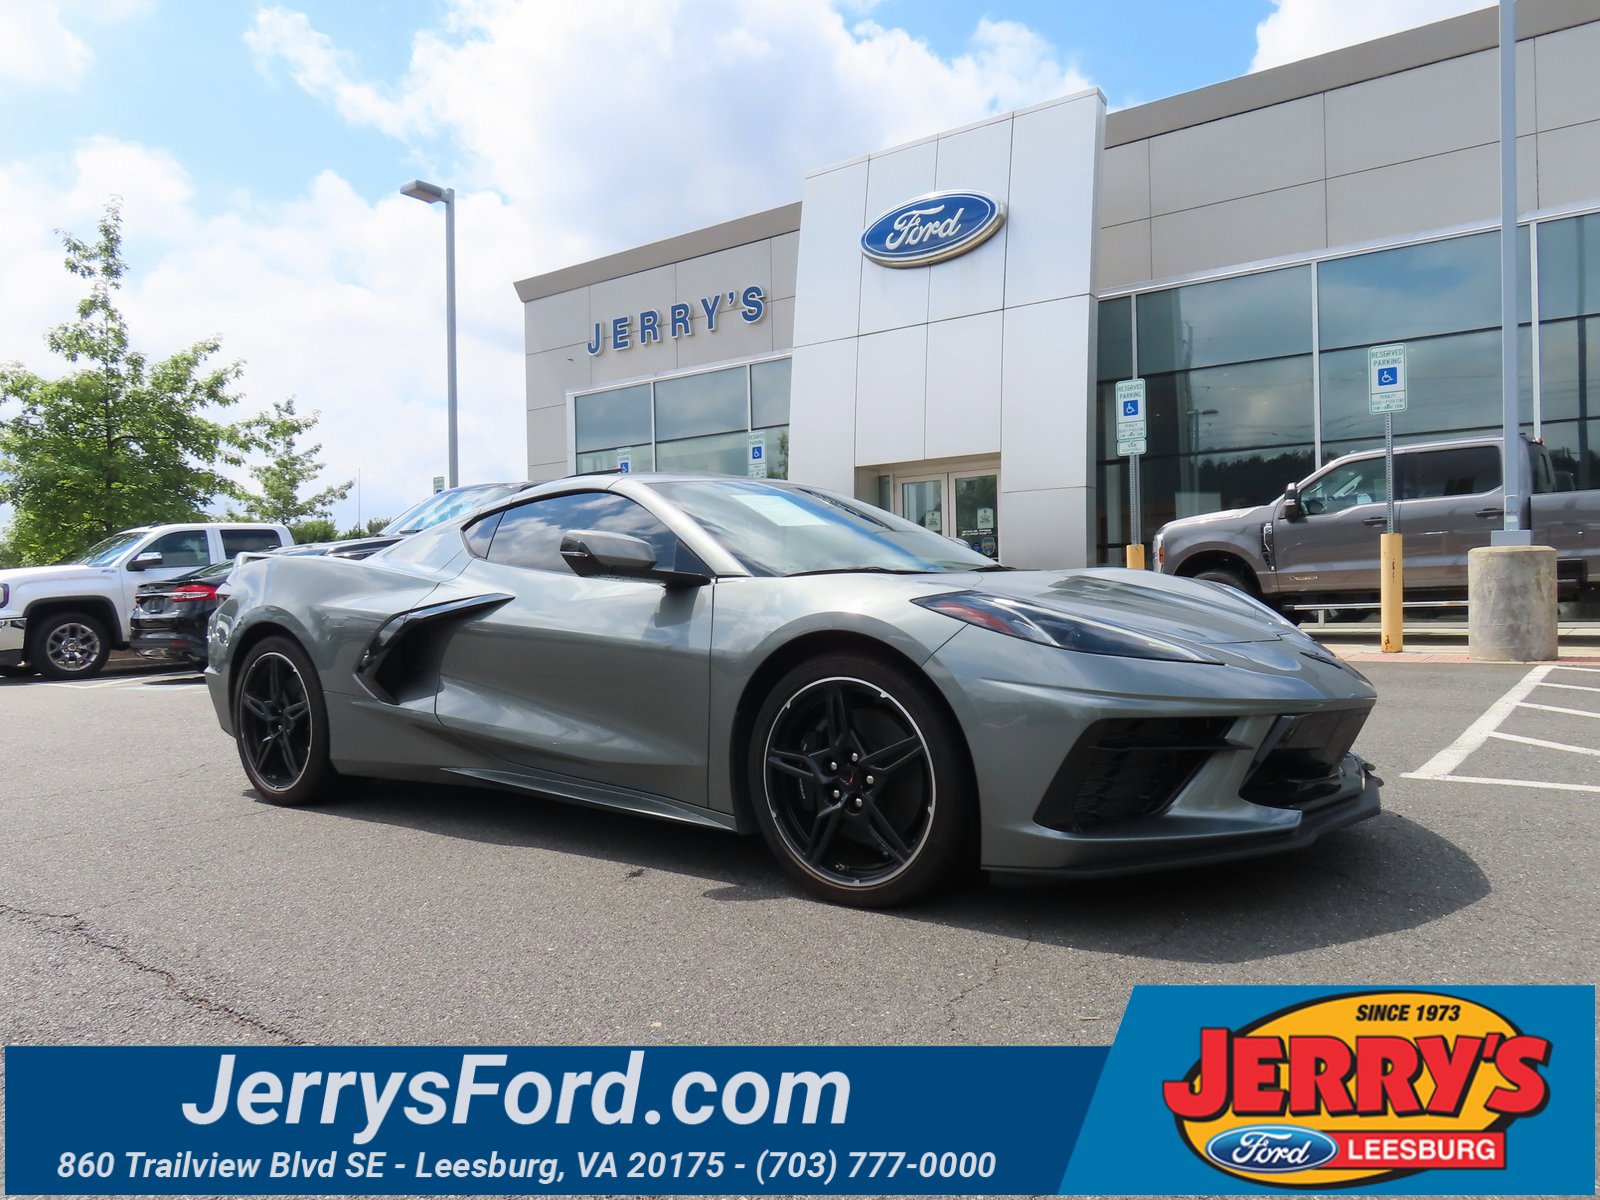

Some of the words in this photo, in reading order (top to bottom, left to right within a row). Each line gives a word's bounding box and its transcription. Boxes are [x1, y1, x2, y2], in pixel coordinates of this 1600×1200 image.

[885, 203, 965, 251] Ford
[587, 285, 767, 357] JERRY'S
[1371, 349, 1403, 358] RESERVED
[1373, 358, 1401, 367] PARKING
